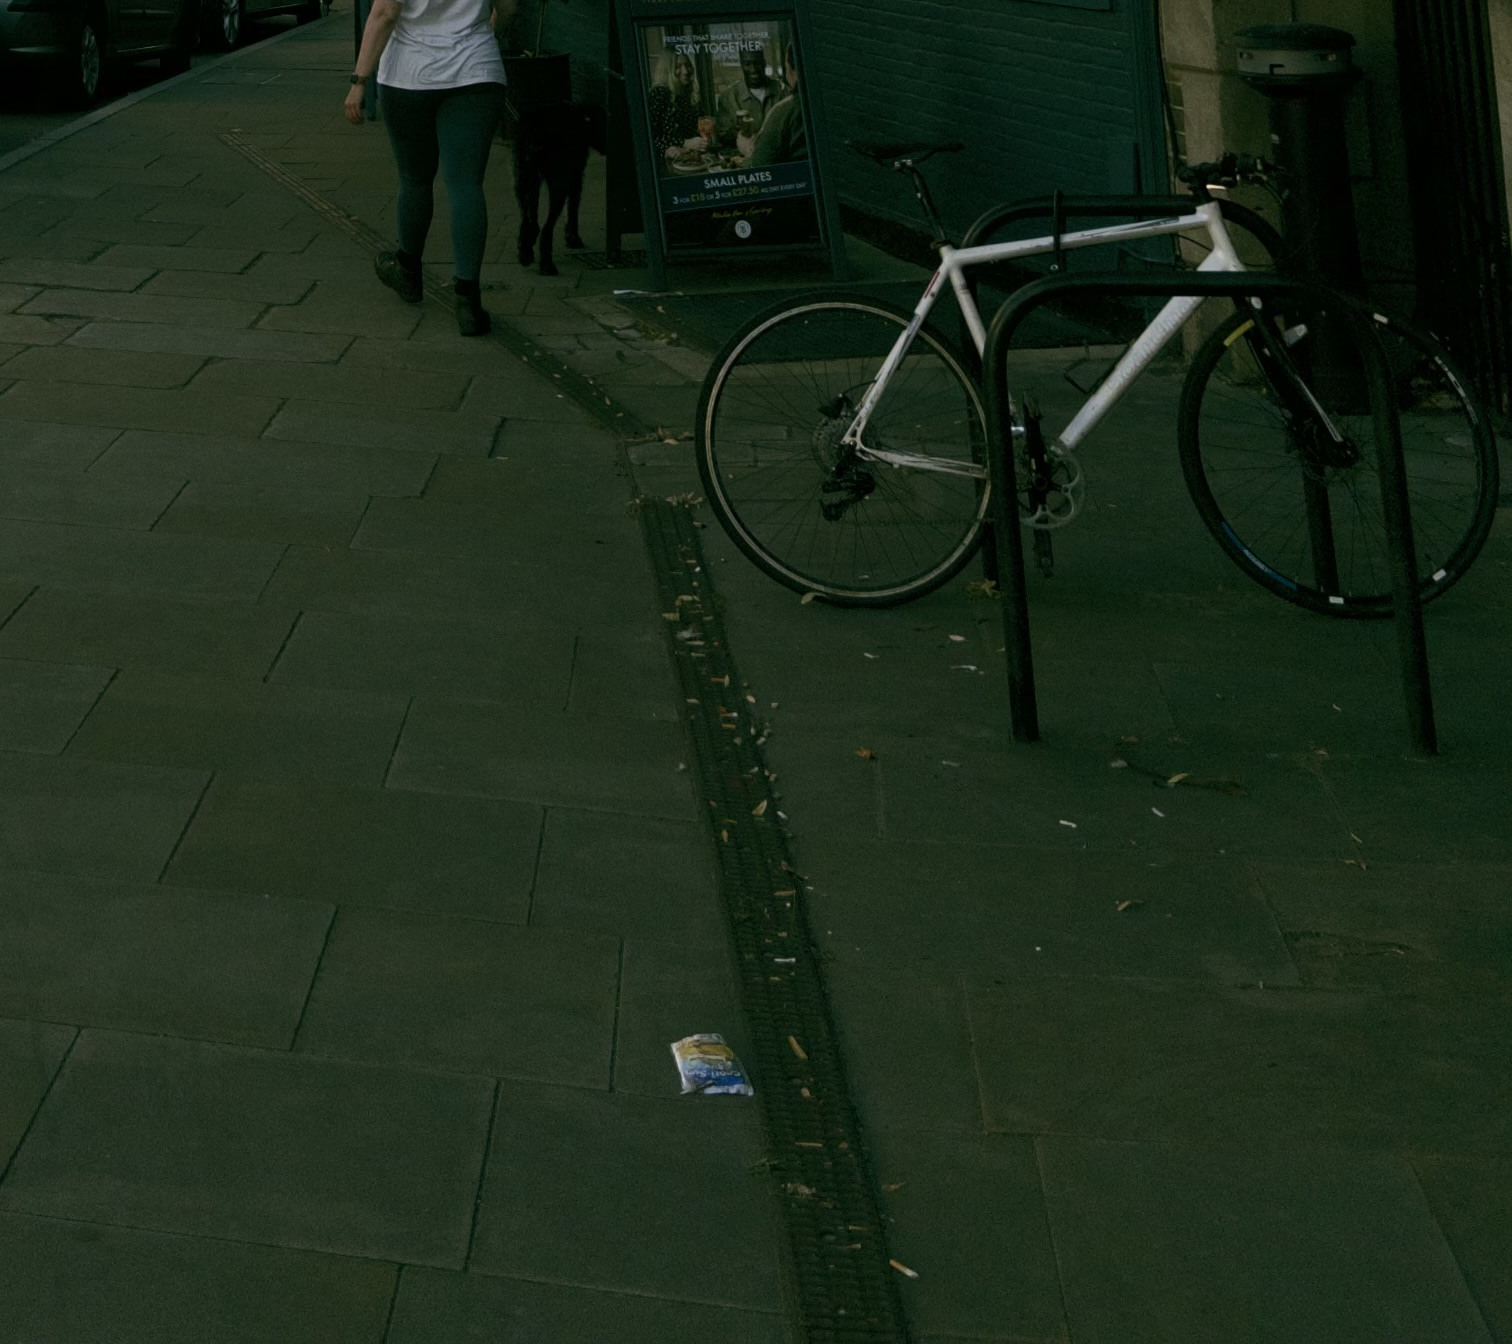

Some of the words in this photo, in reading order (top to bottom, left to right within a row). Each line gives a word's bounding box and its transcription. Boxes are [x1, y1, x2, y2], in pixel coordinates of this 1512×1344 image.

[676, 44, 701, 55] STAY
[704, 41, 762, 53] TOGETHER
[704, 176, 737, 189] SMALL
[738, 171, 772, 184] PLATES
[673, 196, 679, 205] 3
[691, 192, 706, 202] £18
[715, 191, 721, 199] 5
